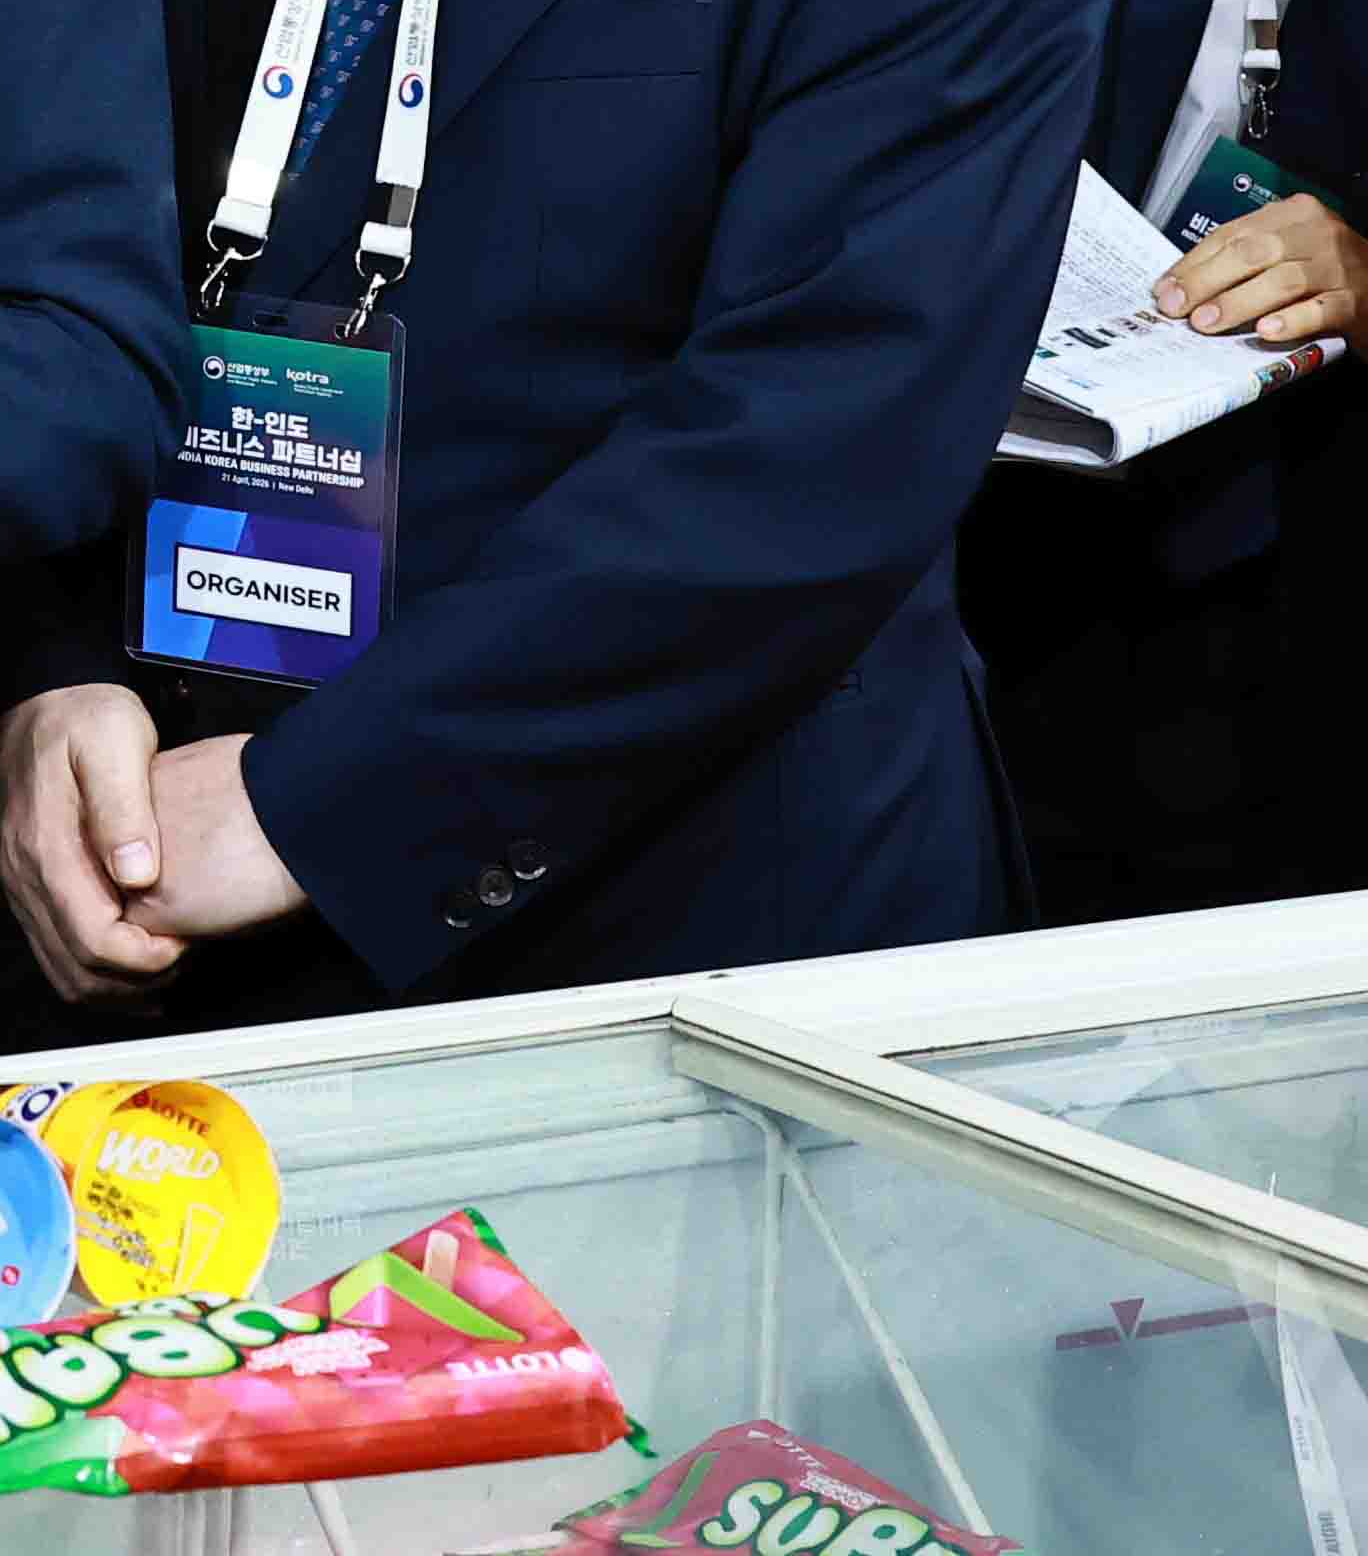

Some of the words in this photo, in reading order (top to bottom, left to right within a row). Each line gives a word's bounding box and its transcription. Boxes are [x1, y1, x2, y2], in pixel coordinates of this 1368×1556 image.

[286, 368, 329, 385] kotra
[231, 405, 309, 439] 한-인도
[178, 451, 202, 464] NDIA
[204, 454, 238, 470] KOREA
[240, 459, 291, 477] BUSINESS
[292, 467, 365, 488] PARTNERSHIP
[272, 439, 362, 474] 파트너십
[187, 570, 341, 612] ORGANISER
[148, 1095, 212, 1134] LOTTE
[96, 1130, 222, 1181] WORLD
[447, 1351, 562, 1380] LOTTE
[701, 1480, 966, 1556] SUB
